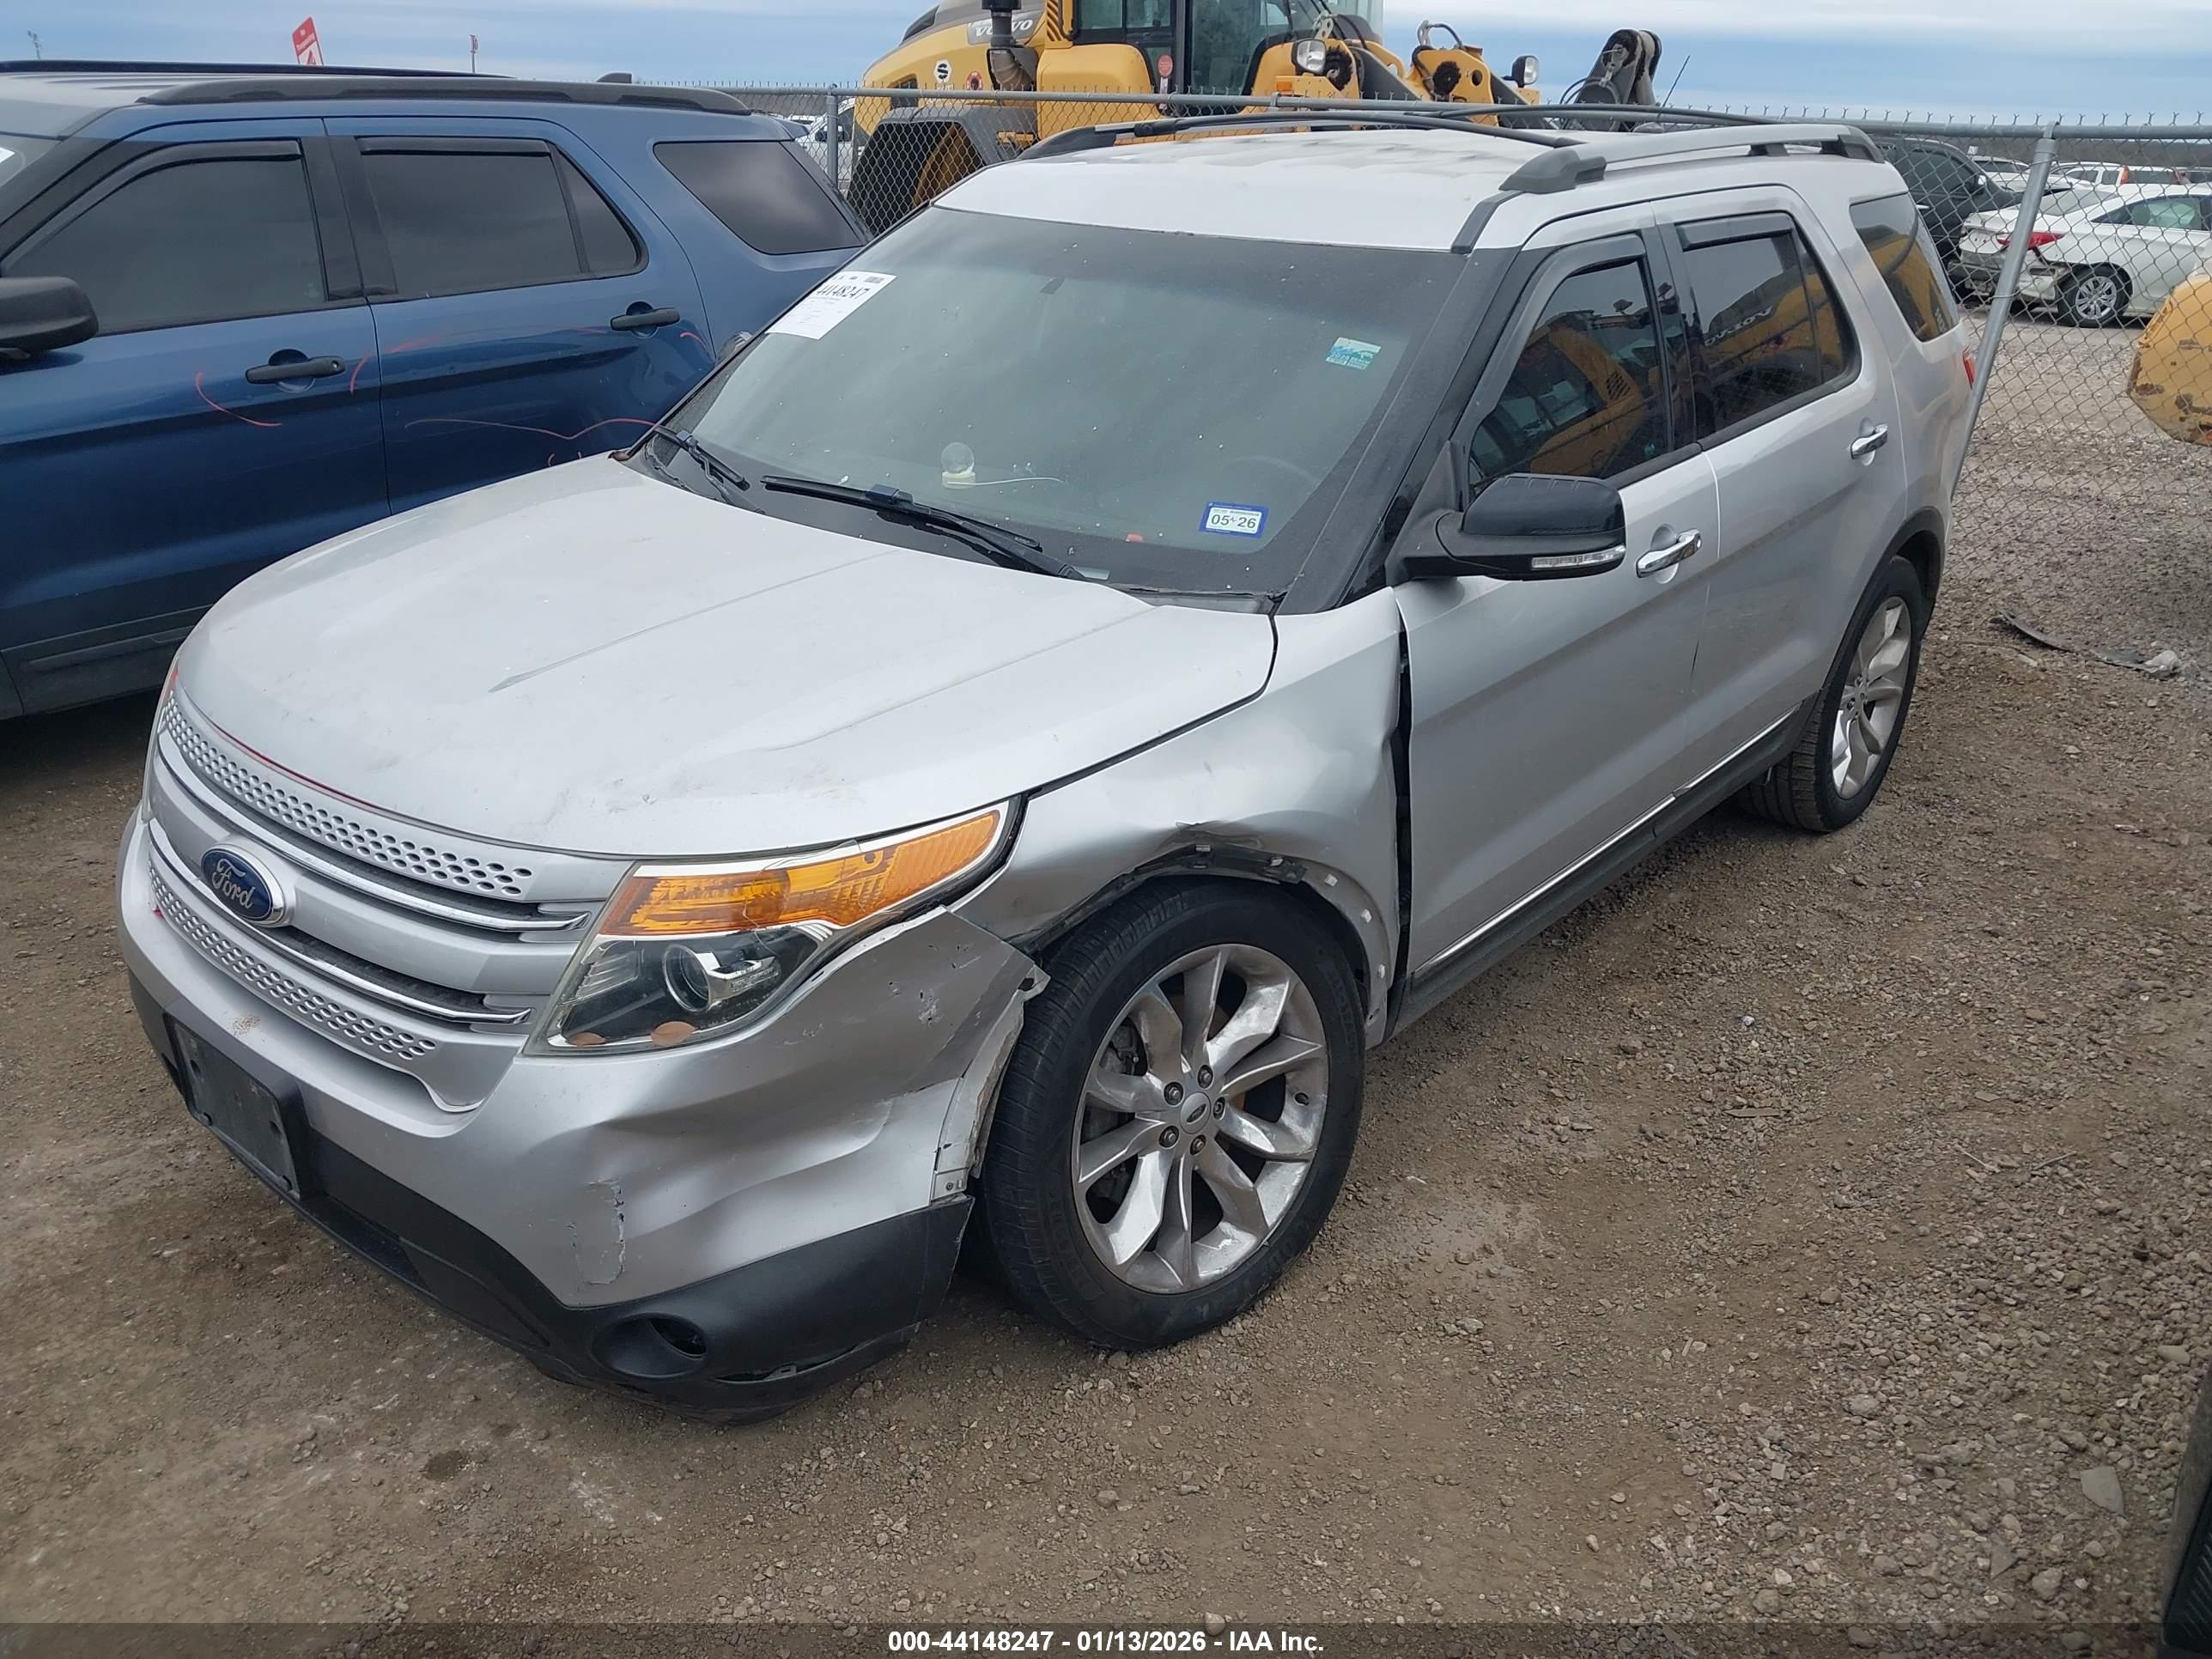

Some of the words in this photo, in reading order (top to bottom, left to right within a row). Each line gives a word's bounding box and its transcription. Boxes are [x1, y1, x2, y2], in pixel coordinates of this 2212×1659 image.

[1211, 514, 1230, 526] 05
[1237, 517, 1257, 528] 26
[212, 858, 256, 908] Ford
